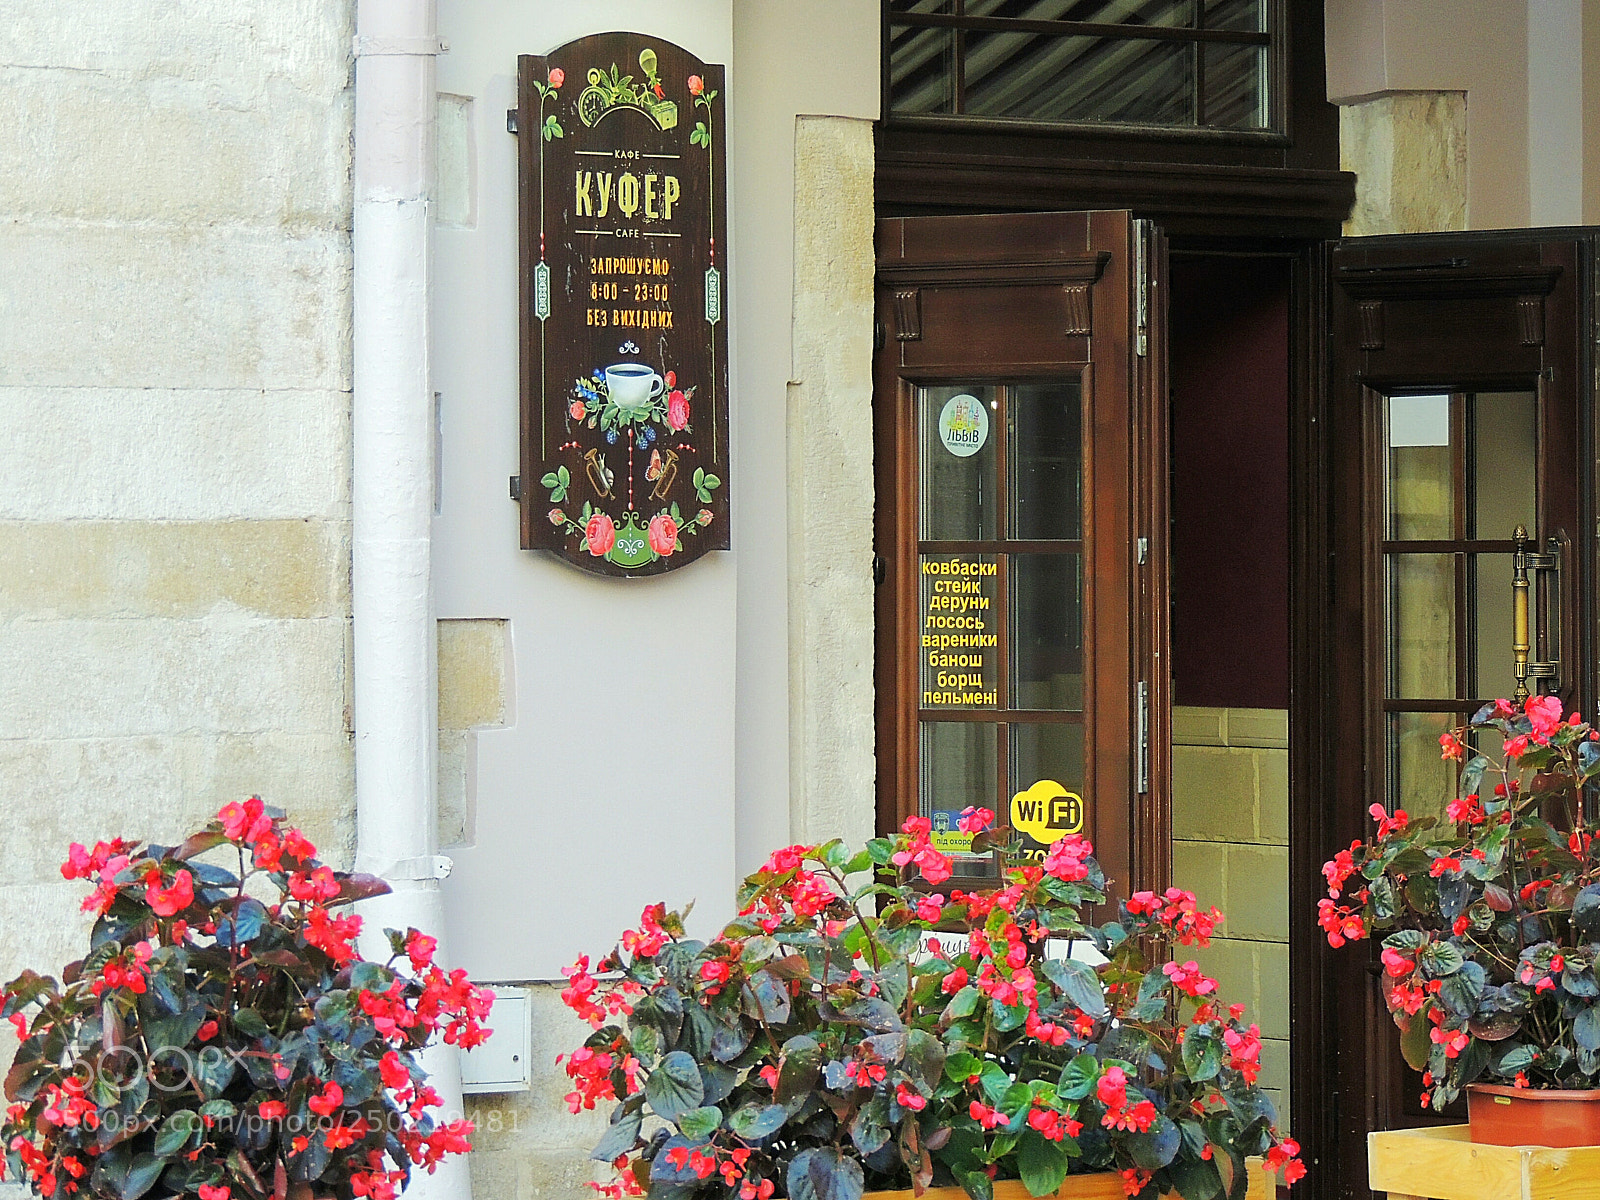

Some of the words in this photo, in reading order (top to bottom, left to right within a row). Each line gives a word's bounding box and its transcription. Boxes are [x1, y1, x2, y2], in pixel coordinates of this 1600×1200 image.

[614, 149, 640, 160] КАФЕ
[575, 169, 681, 220] КУФЕР
[615, 228, 640, 238] CAFE
[590, 256, 670, 276] ЗАПРОШУЄМО
[591, 283, 618, 300] 8:00
[634, 284, 669, 301] 23:00
[586, 309, 607, 327] БЕЗ
[613, 309, 674, 328] ВИХІДНИХ
[946, 428, 979, 443] ЛЬВІВ
[922, 559, 997, 577] ковбаски
[934, 577, 981, 594] стейк
[929, 596, 990, 611] деруни
[925, 616, 985, 630] лосось
[921, 633, 998, 649] вареники
[929, 650, 983, 667] банош
[937, 670, 983, 688] борщ
[922, 688, 997, 705] пельмені
[936, 837, 948, 845] під
[950, 838, 972, 846] охоро
